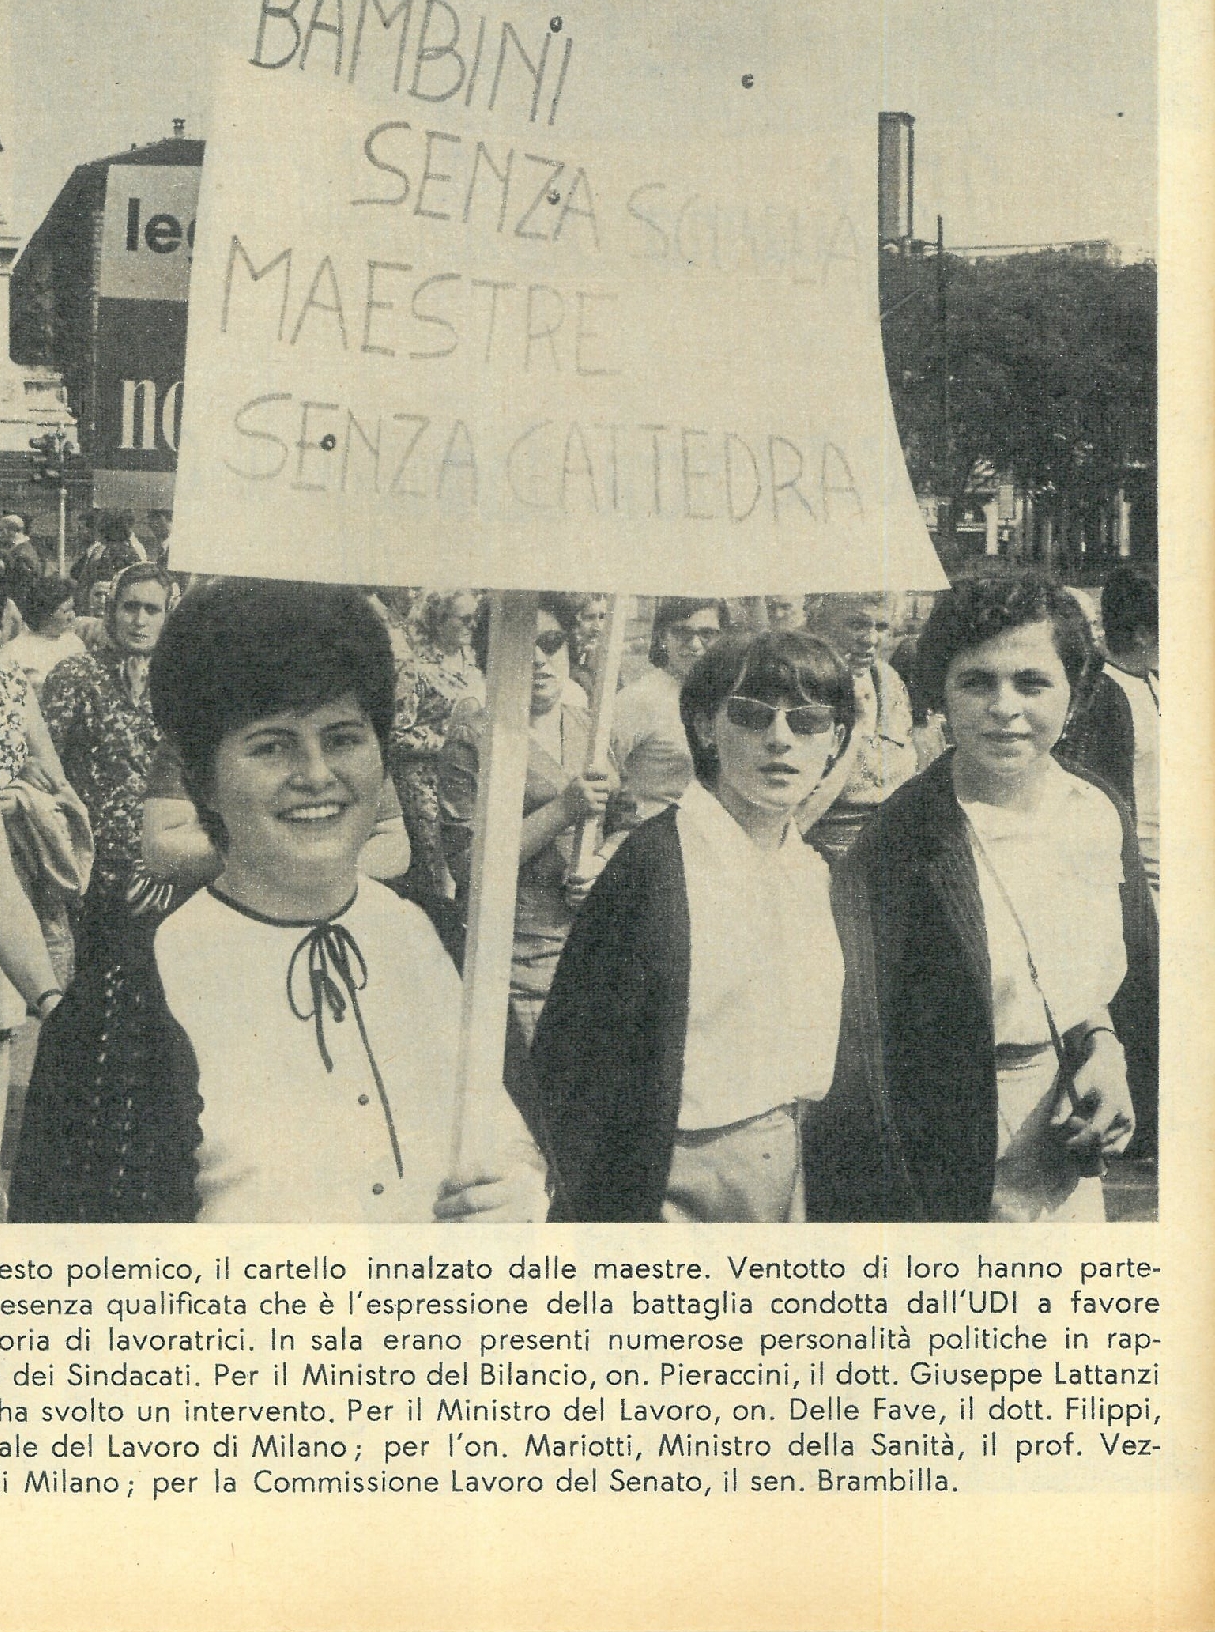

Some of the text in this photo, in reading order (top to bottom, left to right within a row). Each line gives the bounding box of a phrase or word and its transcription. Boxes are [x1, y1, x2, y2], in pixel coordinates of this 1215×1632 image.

[350, 122, 600, 250] SENZA
[220, 234, 622, 378] MAESTRE
[224, 393, 866, 525] SENZA CATTEDRA
[68, 1256, 201, 1286] polemico,
[216, 1257, 229, 1279] il
[244, 1256, 345, 1279] cartello
[369, 1256, 492, 1279] innalzato
[509, 1255, 576, 1279] dalle
[595, 1260, 709, 1279] maestre.
[728, 1257, 845, 1279] Ventotto
[863, 1255, 887, 1278] di
[908, 1255, 959, 1278] loro
[979, 1255, 1062, 1278] hanno
[1081, 1258, 1160, 1285] parte-
[25, 1469, 133, 1497] Milano;
[154, 1477, 198, 1498] per
[215, 1469, 236, 1493] la
[254, 1470, 438, 1493] Commissione
[452, 1470, 543, 1492] Lavoro
[557, 1468, 595, 1492] del
[610, 1469, 711, 1496] Senato,
[724, 1468, 737, 1492] il
[751, 1476, 804, 1491] sen.
[819, 1468, 957, 1492] Brambilla.
